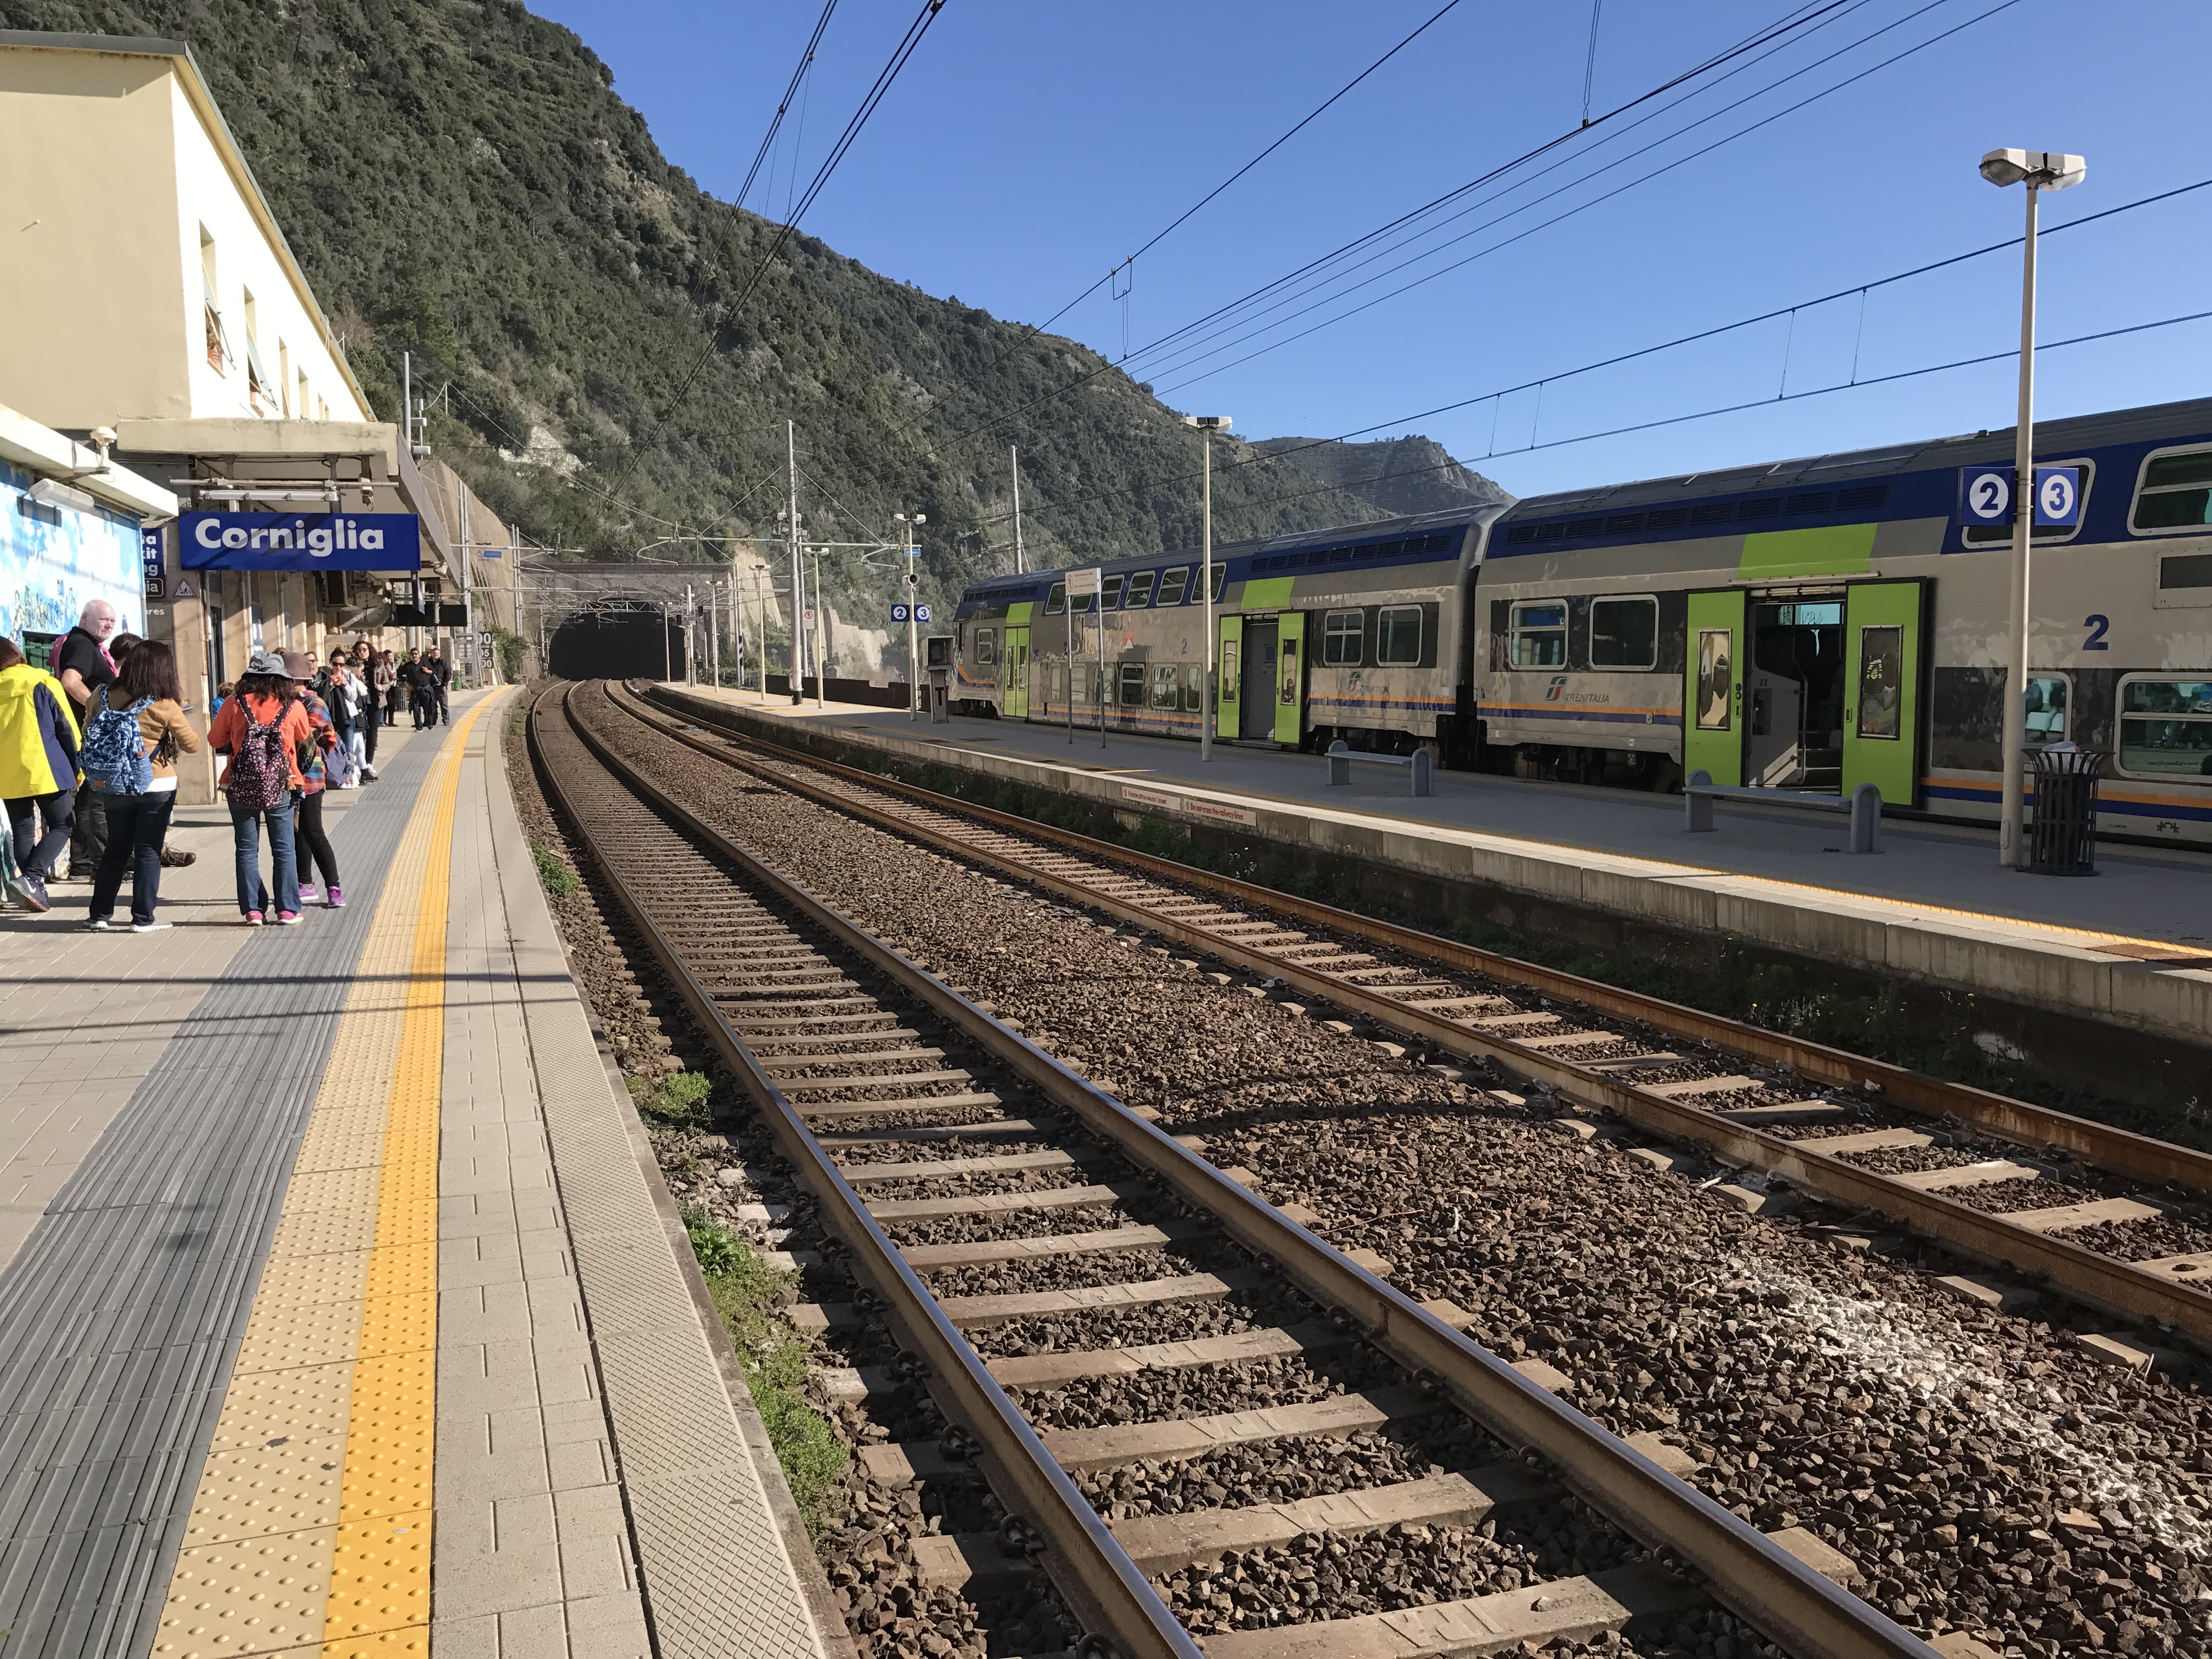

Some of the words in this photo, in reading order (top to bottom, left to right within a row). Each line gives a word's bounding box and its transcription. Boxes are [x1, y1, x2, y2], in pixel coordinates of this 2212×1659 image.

[1979, 481, 1999, 510] 2
[2049, 482, 2066, 511] 3
[195, 518, 384, 557] Corniglia
[896, 608, 904, 617] 2
[920, 609, 927, 617] 3
[2082, 614, 2109, 651] 2
[1181, 638, 1187, 654] 2
[1566, 693, 1609, 703] TRENITALIA
[1190, 803, 1195, 811] Do
